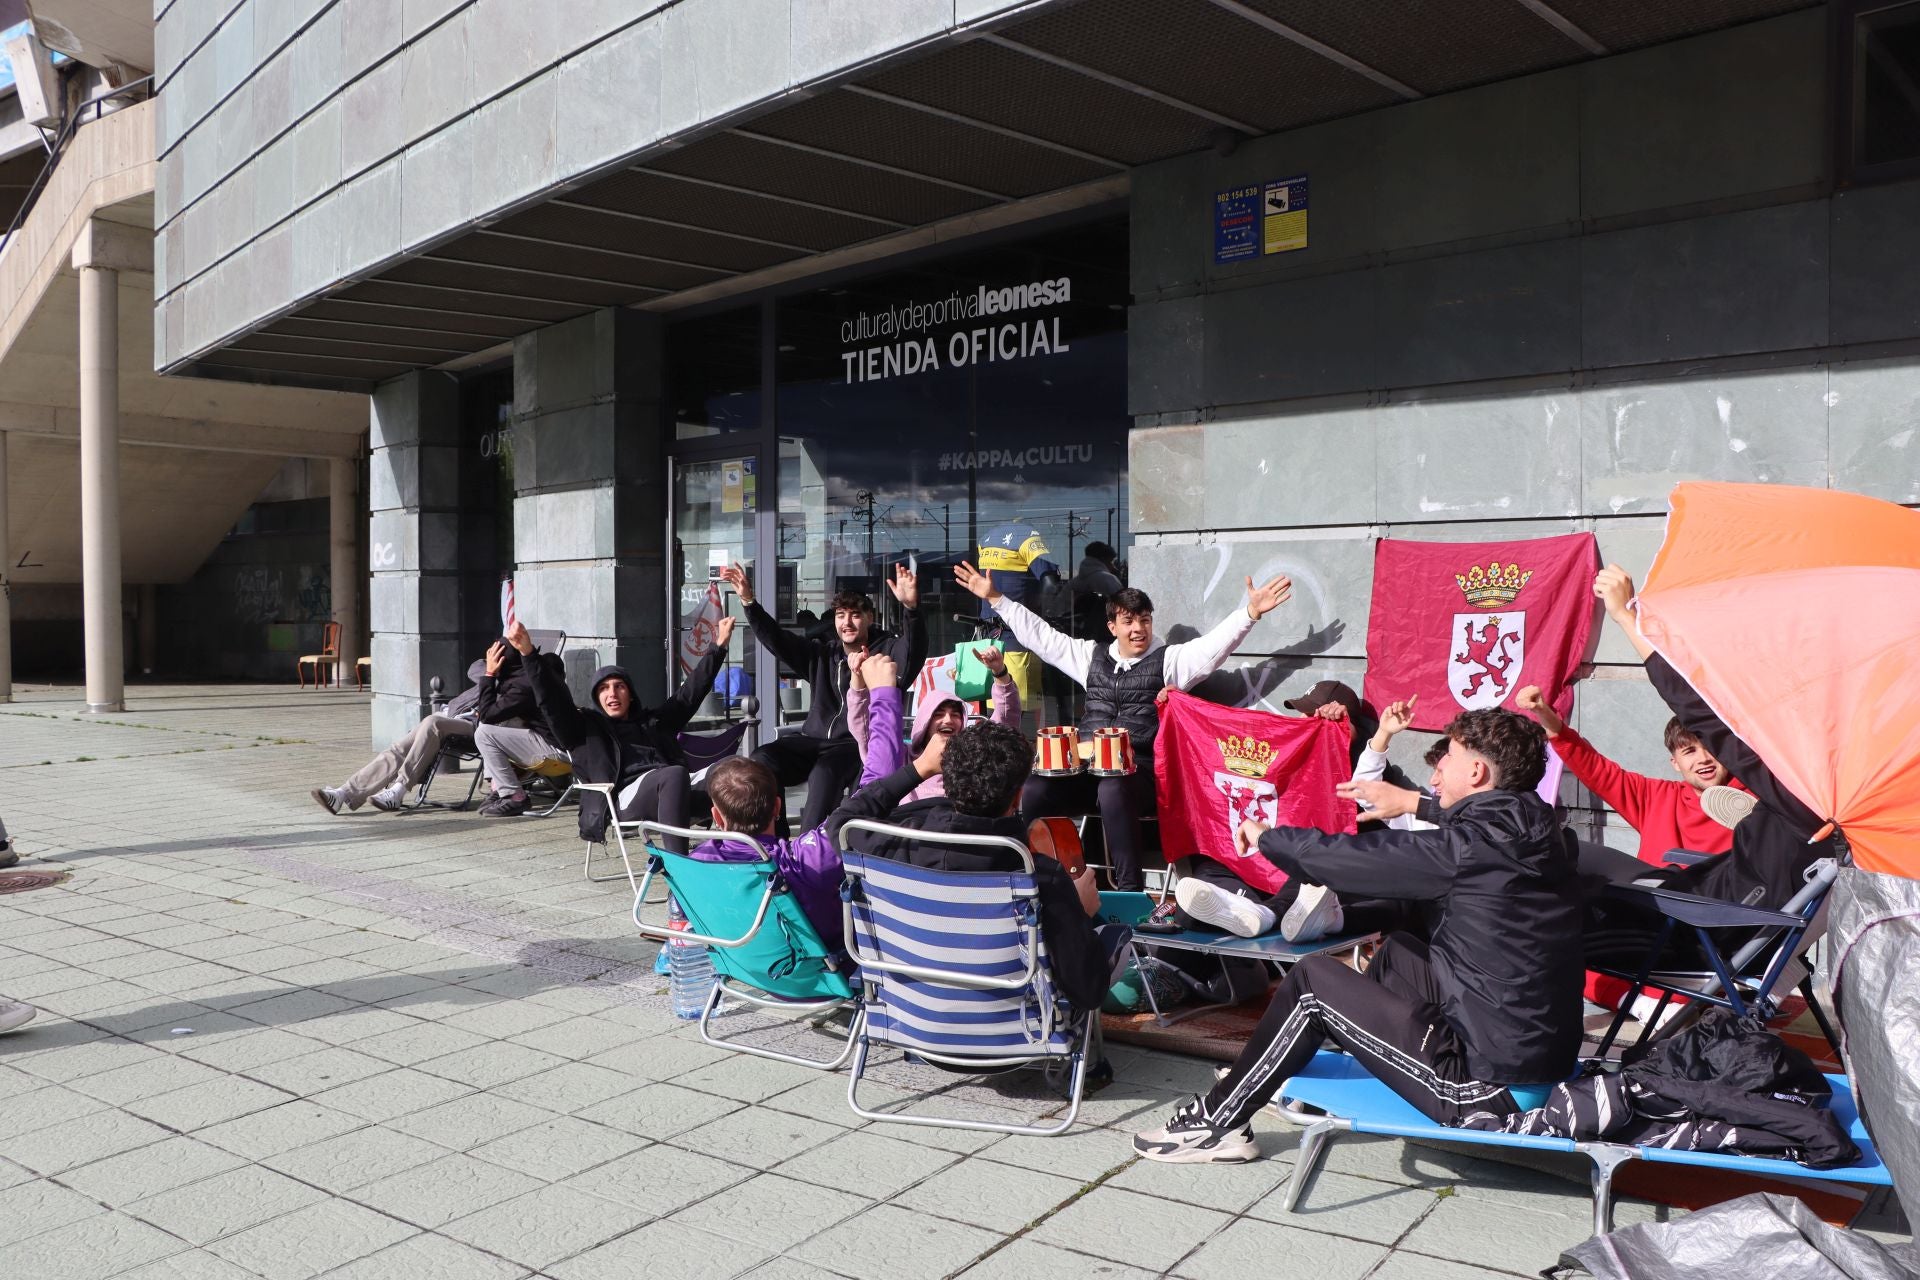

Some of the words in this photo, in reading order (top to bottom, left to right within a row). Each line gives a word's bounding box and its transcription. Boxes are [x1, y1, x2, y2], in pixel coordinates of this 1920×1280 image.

[1217, 193, 1230, 203] 902
[1231, 190, 1243, 199] 154
[1245, 186, 1258, 198] 539
[841, 337, 940, 384] TIENDA
[949, 316, 1070, 368] OFICIAL
[938, 444, 1093, 471] #KAPPA4CULTU
